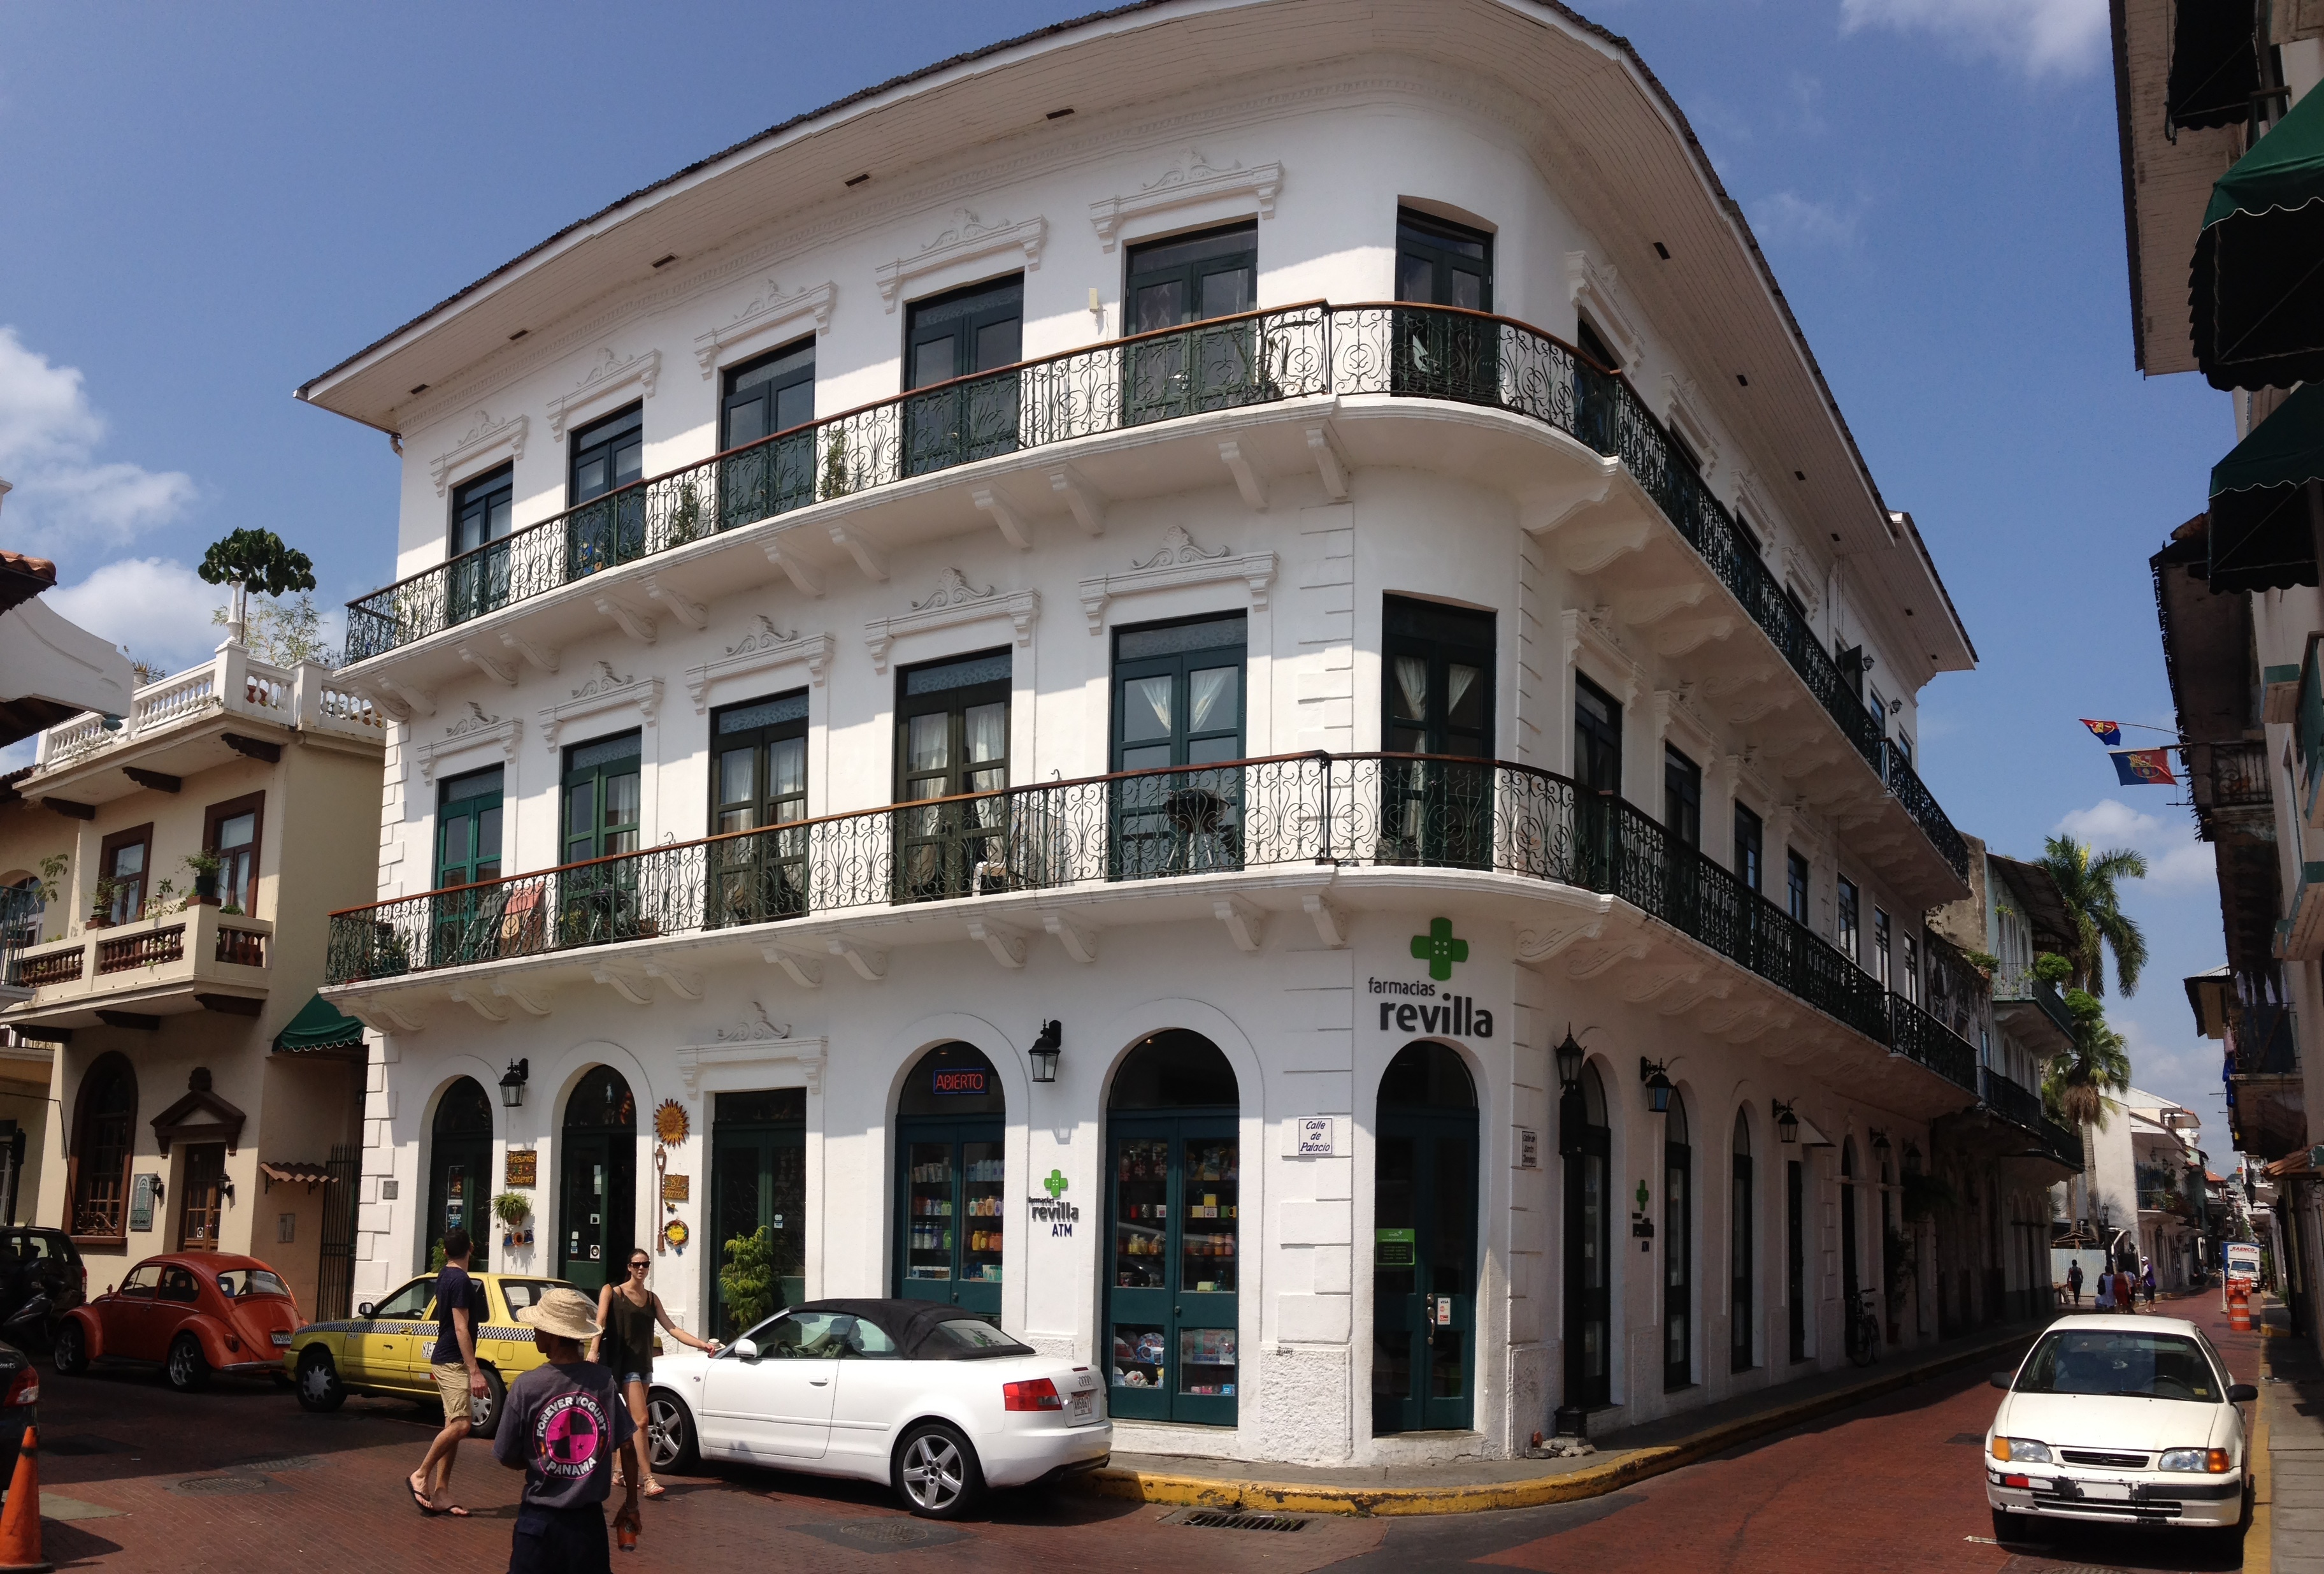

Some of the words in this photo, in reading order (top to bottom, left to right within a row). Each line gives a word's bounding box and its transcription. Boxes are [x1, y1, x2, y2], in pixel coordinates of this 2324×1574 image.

[1368, 976, 1435, 996] farmacias
[1380, 992, 1493, 1038] revilla
[935, 1074, 984, 1090] ABIERTO
[1306, 1120, 1326, 1129] Calle
[1310, 1131, 1321, 1140] de
[1300, 1142, 1330, 1152] Palacio
[1032, 1201, 1079, 1220] revilla
[1052, 1224, 1072, 1237] ATM
[536, 1397, 573, 1437] FOREVER
[575, 1396, 606, 1431] YOGURT
[546, 1457, 597, 1476] PANAMA
